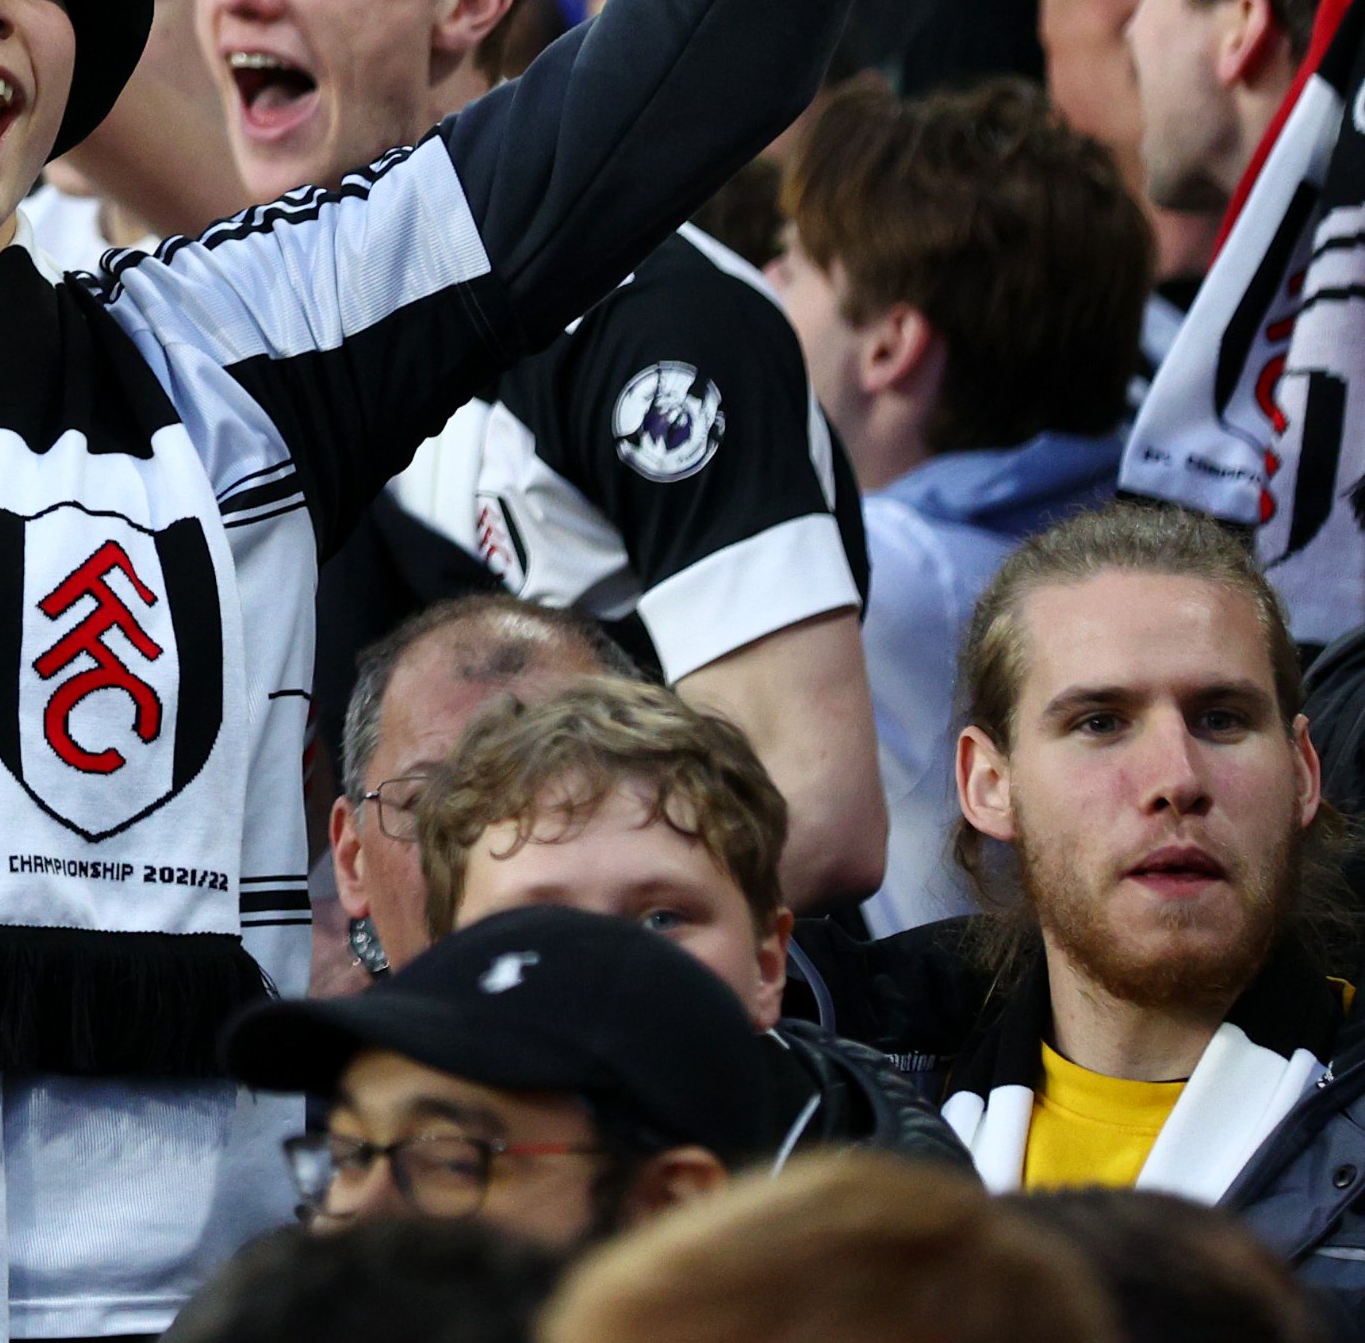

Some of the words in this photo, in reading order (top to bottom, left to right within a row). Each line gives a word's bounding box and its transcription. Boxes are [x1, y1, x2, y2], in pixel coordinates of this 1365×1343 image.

[32, 539, 164, 775] FFC
[9, 855, 134, 882] CHAMPIONSHIP
[143, 864, 229, 892] 2021/22
